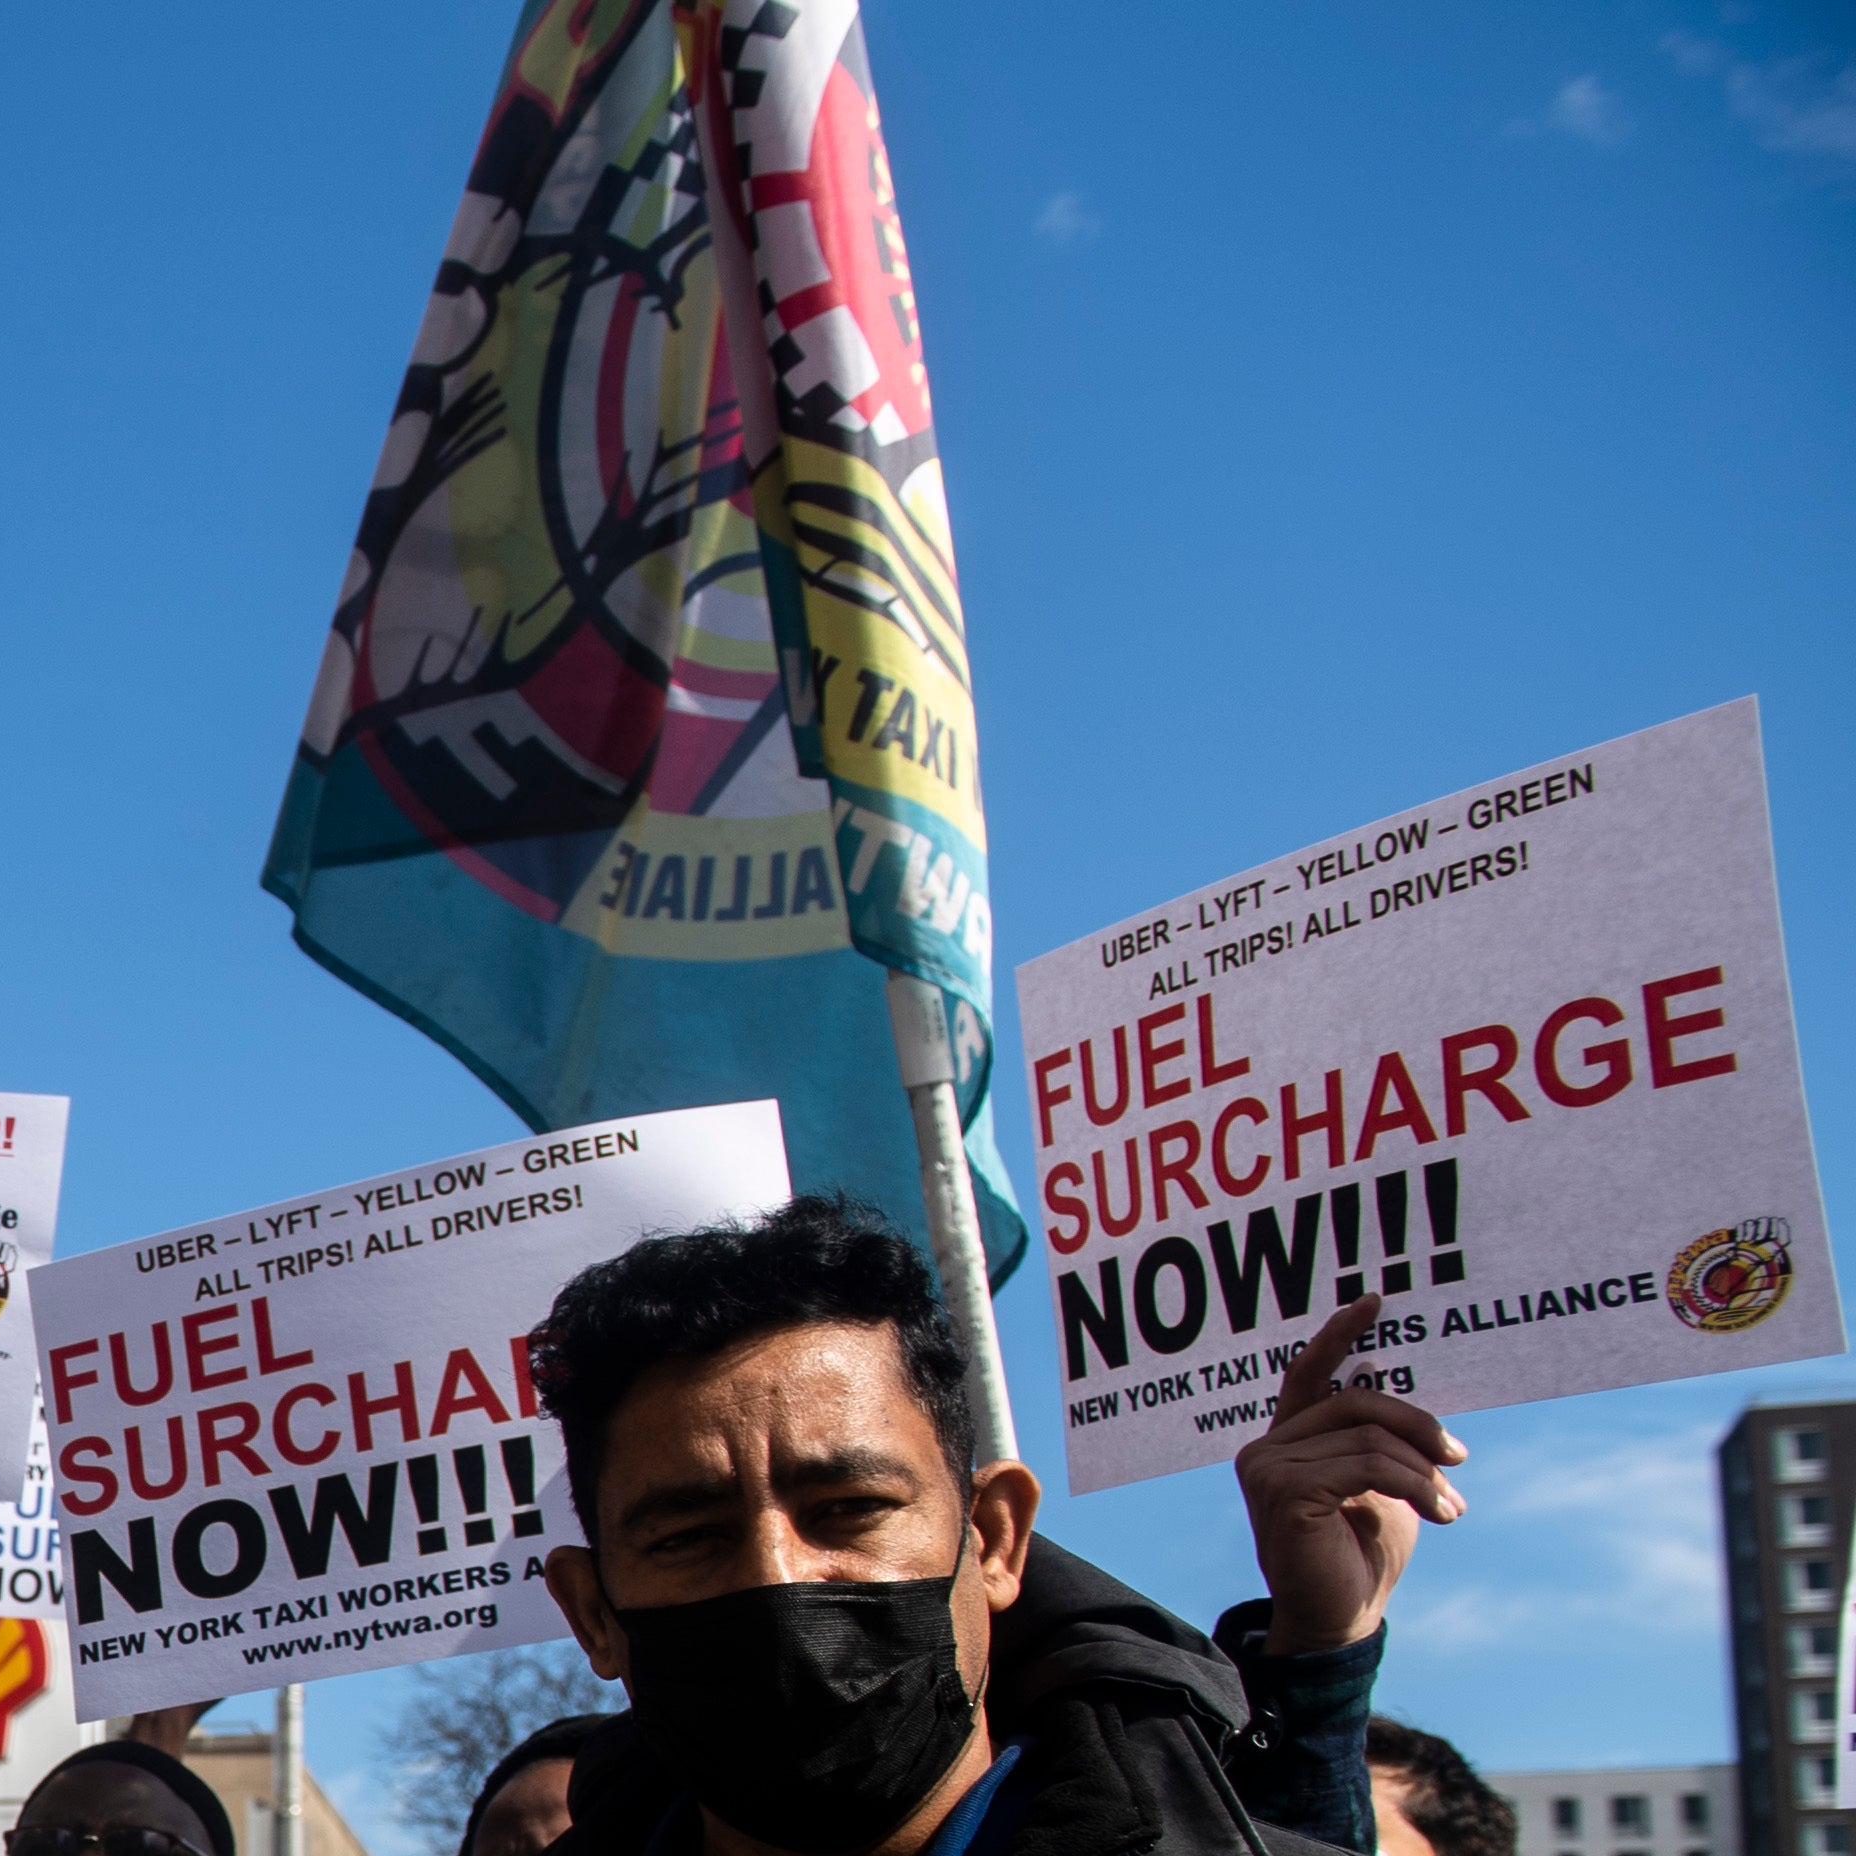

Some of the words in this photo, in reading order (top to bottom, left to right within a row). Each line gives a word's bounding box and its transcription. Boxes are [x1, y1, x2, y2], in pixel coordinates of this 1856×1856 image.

[850, 667, 958, 789] TAXI
[1101, 919, 1171, 968] UBER
[1198, 879, 1265, 930] LYFT
[1296, 819, 1429, 890] YELLOW
[1467, 763, 1593, 830] GREEN
[1032, 993, 1250, 1151] FUEL
[1040, 966, 1737, 1255] SURCHARGE
[135, 1233, 218, 1273] UBER
[248, 1204, 321, 1245] LYFT
[353, 1162, 486, 1216] YELLOW
[522, 1130, 638, 1173] GREEN
[1053, 1157, 1466, 1384] NOW!!!
[1440, 1272, 1658, 1338] ALLIANCE
[45, 1296, 314, 1428] FUEL
[1068, 1391, 1118, 1429] NEW
[1124, 1371, 1194, 1412] YORK
[1198, 1353, 1259, 1392] TAXI
[67, 1435, 546, 1629] NOW!!!
[76, 1632, 146, 1669] NEW
[154, 1612, 245, 1649] YORK
[252, 1595, 328, 1629] TAXI
[337, 1560, 511, 1613] WORKERS
[242, 1604, 498, 1665] www.nytwa.org
